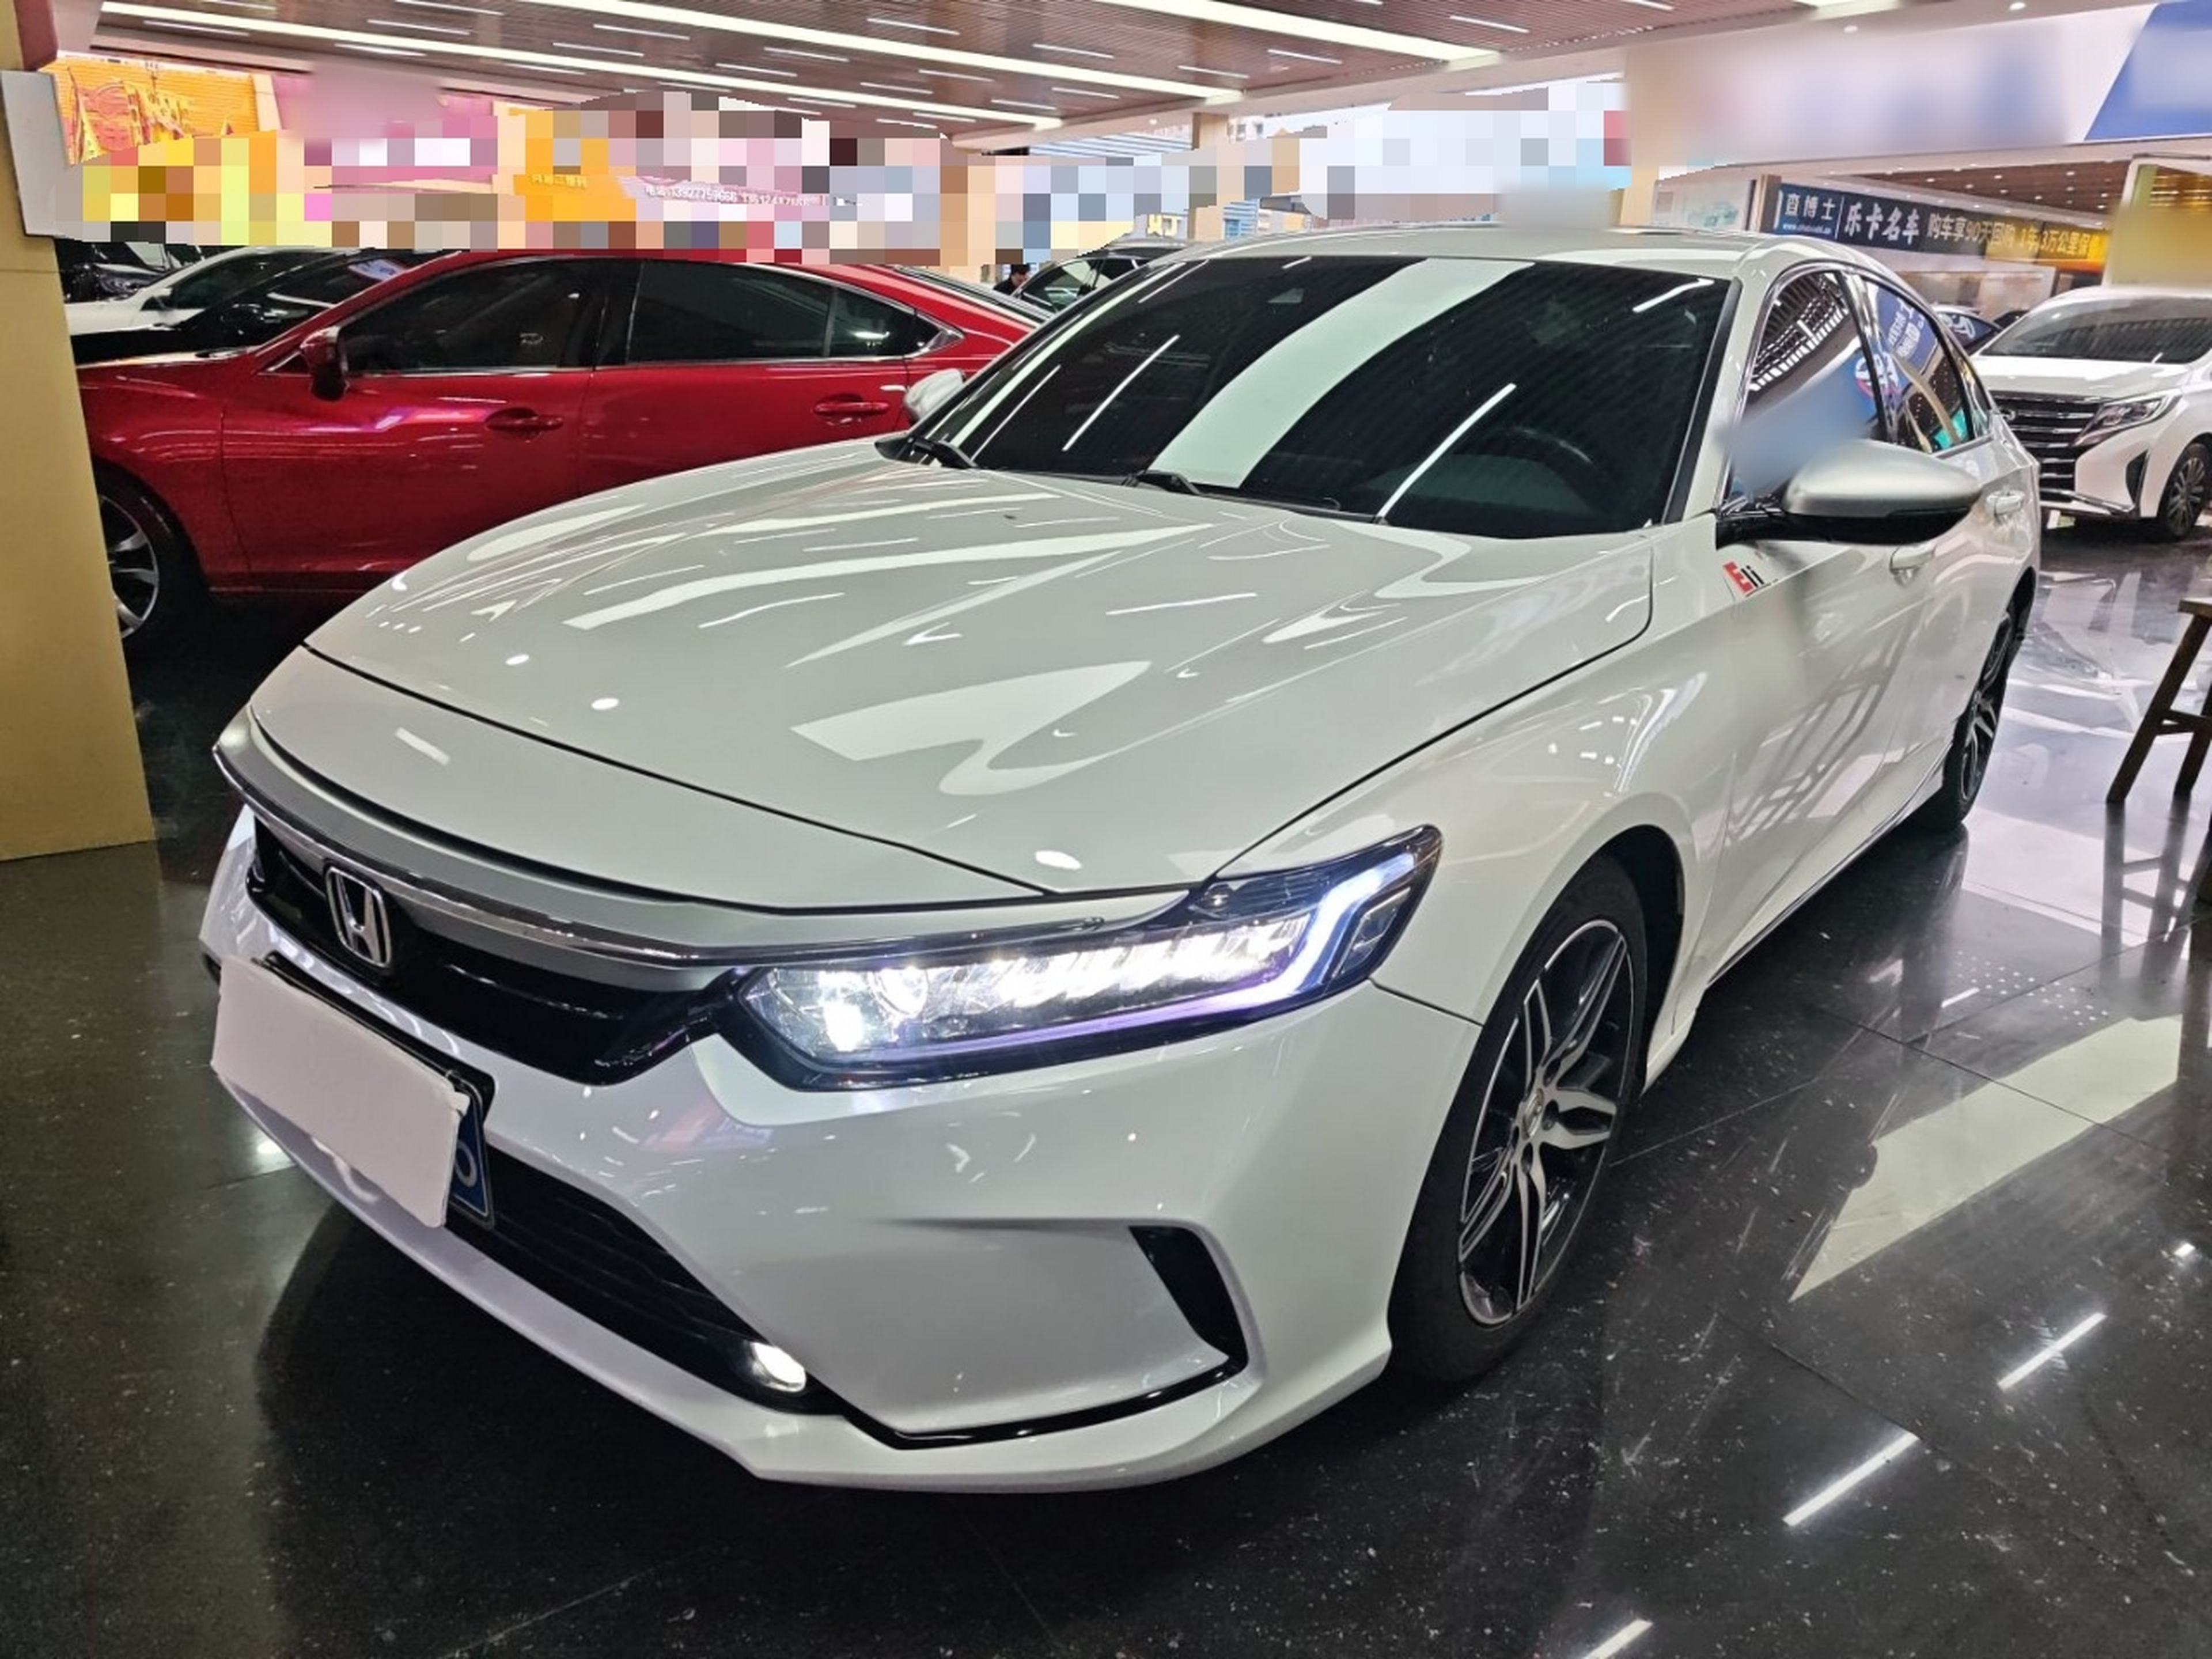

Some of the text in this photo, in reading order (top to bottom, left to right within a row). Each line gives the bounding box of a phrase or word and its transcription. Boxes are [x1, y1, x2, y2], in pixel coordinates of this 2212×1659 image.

[1785, 193, 1836, 221] 查博士
[1844, 202, 1920, 245] 乐卡名车
